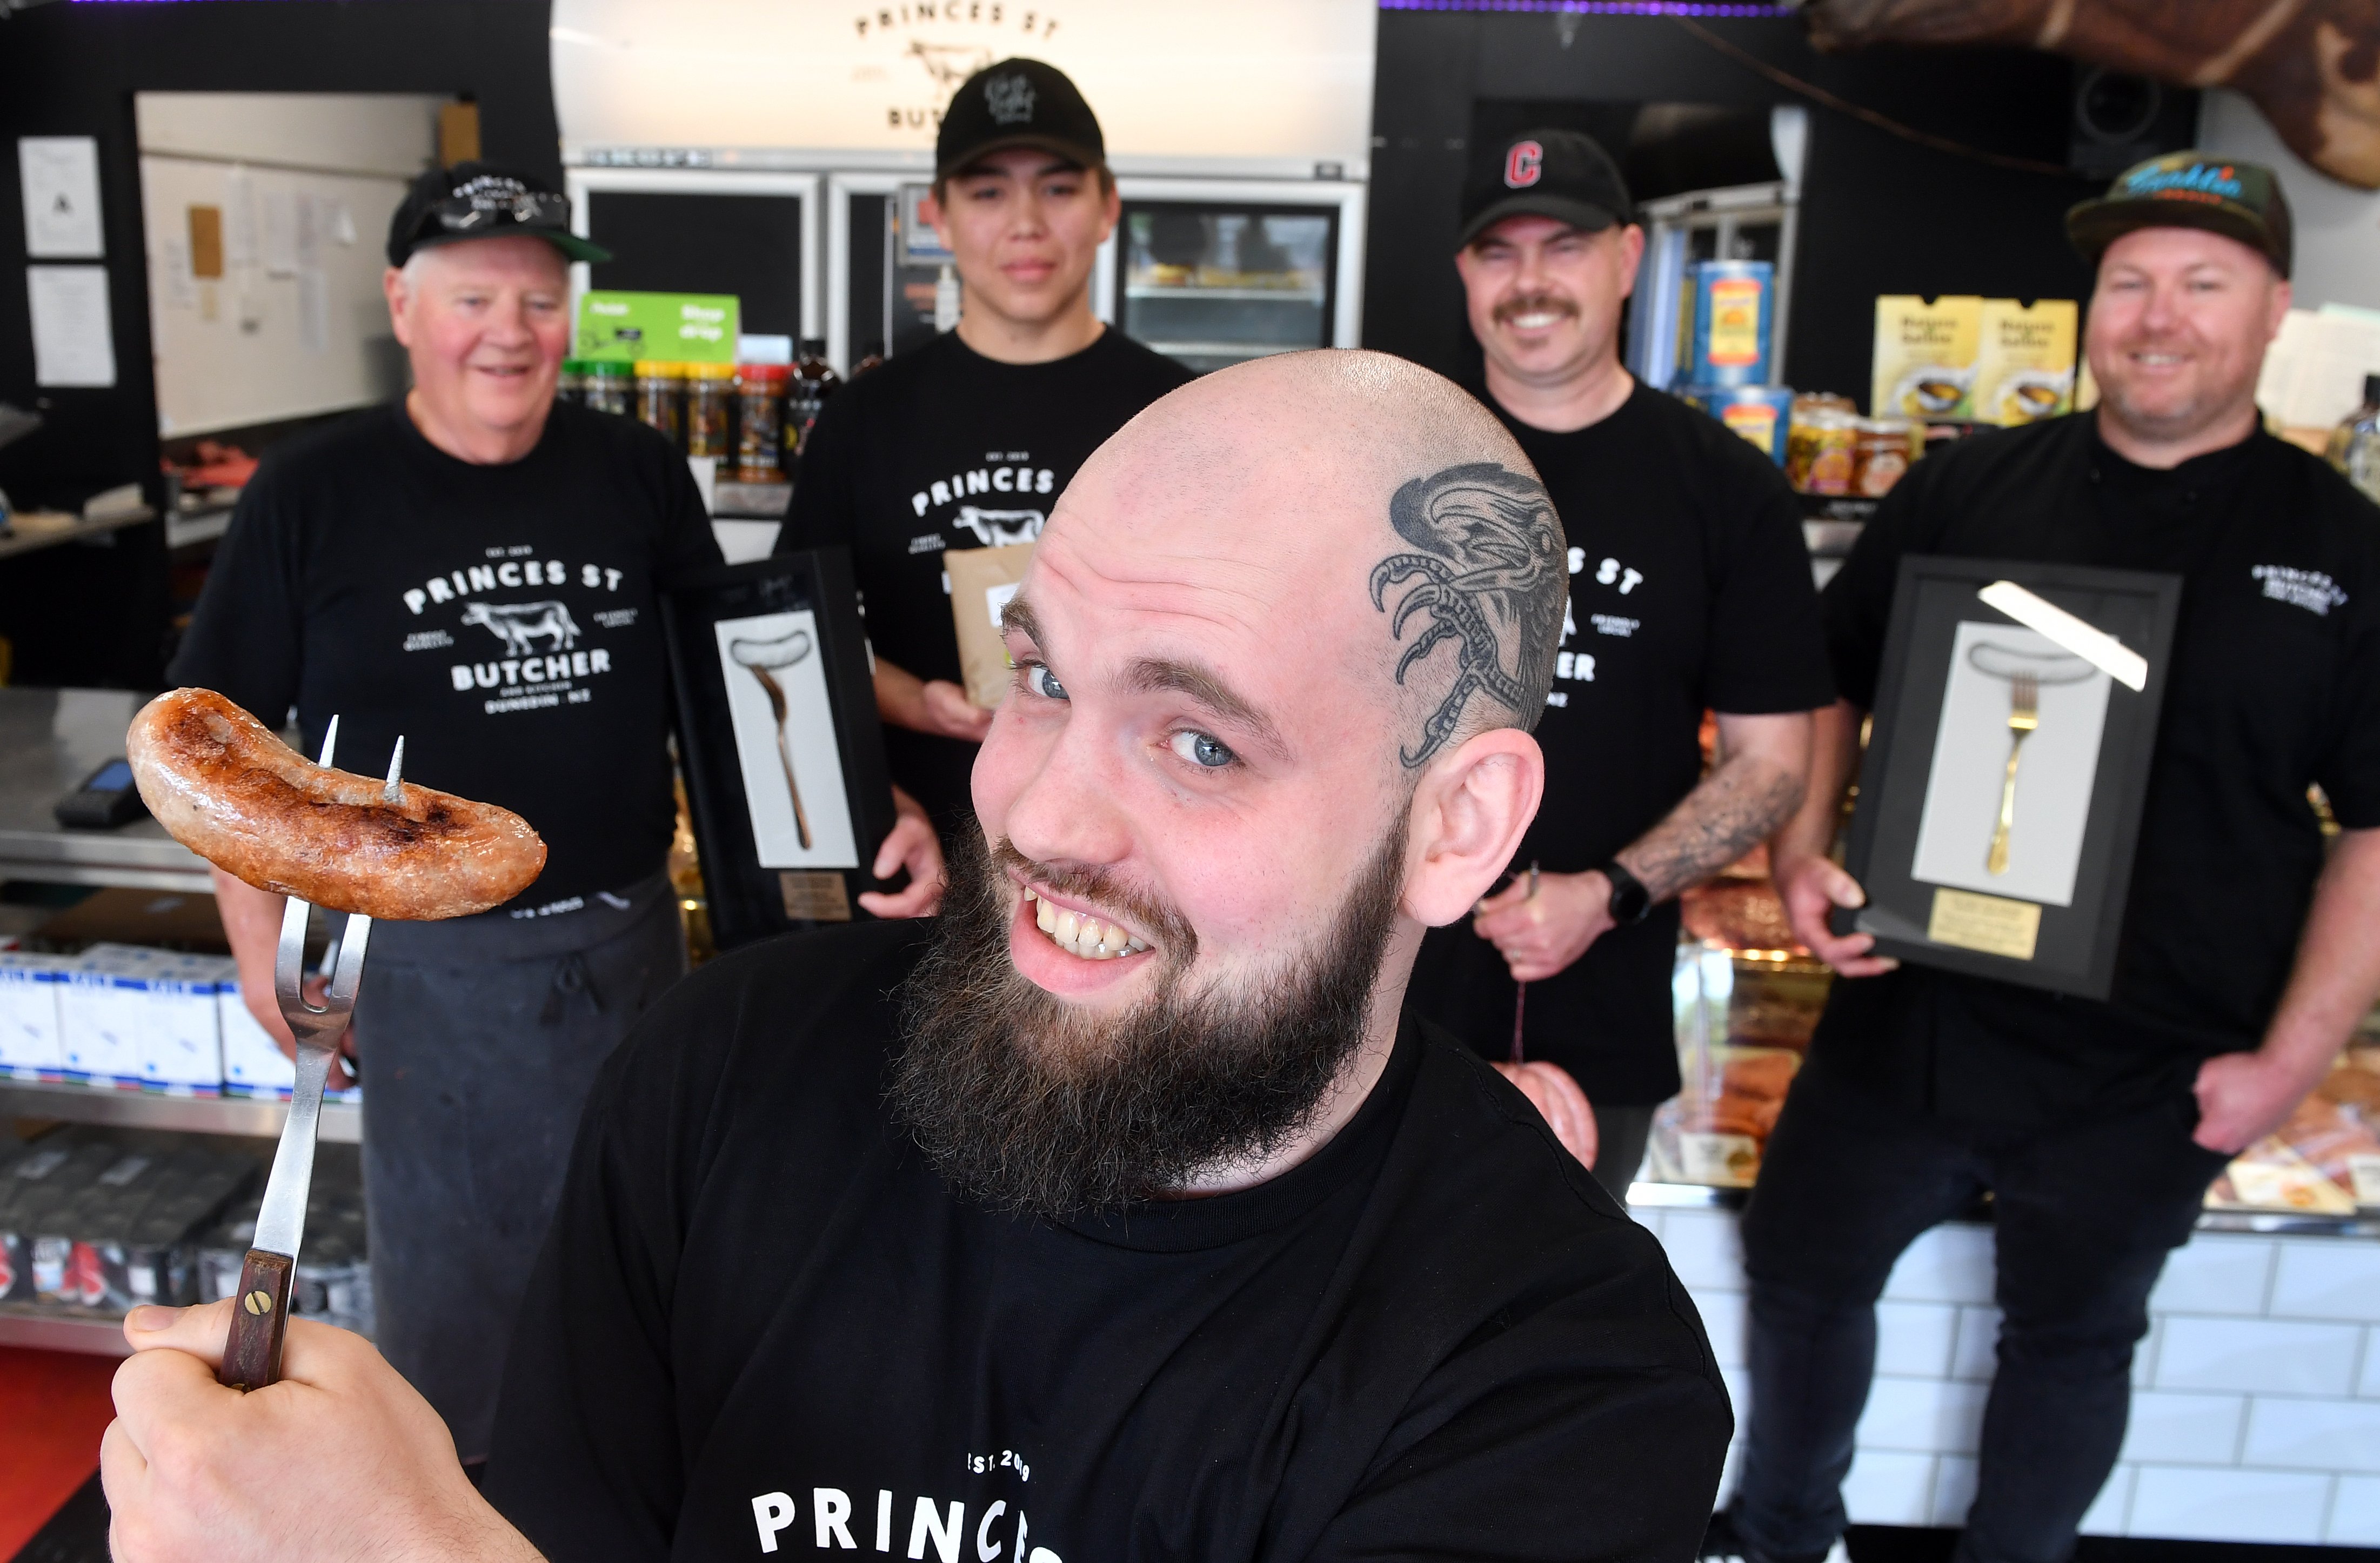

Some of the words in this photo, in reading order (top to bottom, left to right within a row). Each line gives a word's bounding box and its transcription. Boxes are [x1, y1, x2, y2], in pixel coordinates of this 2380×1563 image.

[855, 0, 1002, 37] PRINCES
[1024, 11, 1061, 41] ST
[1504, 140, 1543, 189] C
[911, 466, 1055, 517] PRINCES
[403, 559, 566, 615] PRINCES
[581, 563, 623, 592] ST
[1595, 557, 1644, 595] ST
[450, 649, 611, 691] BUTCHER
[752, 1487, 1063, 1563] PRINCE
